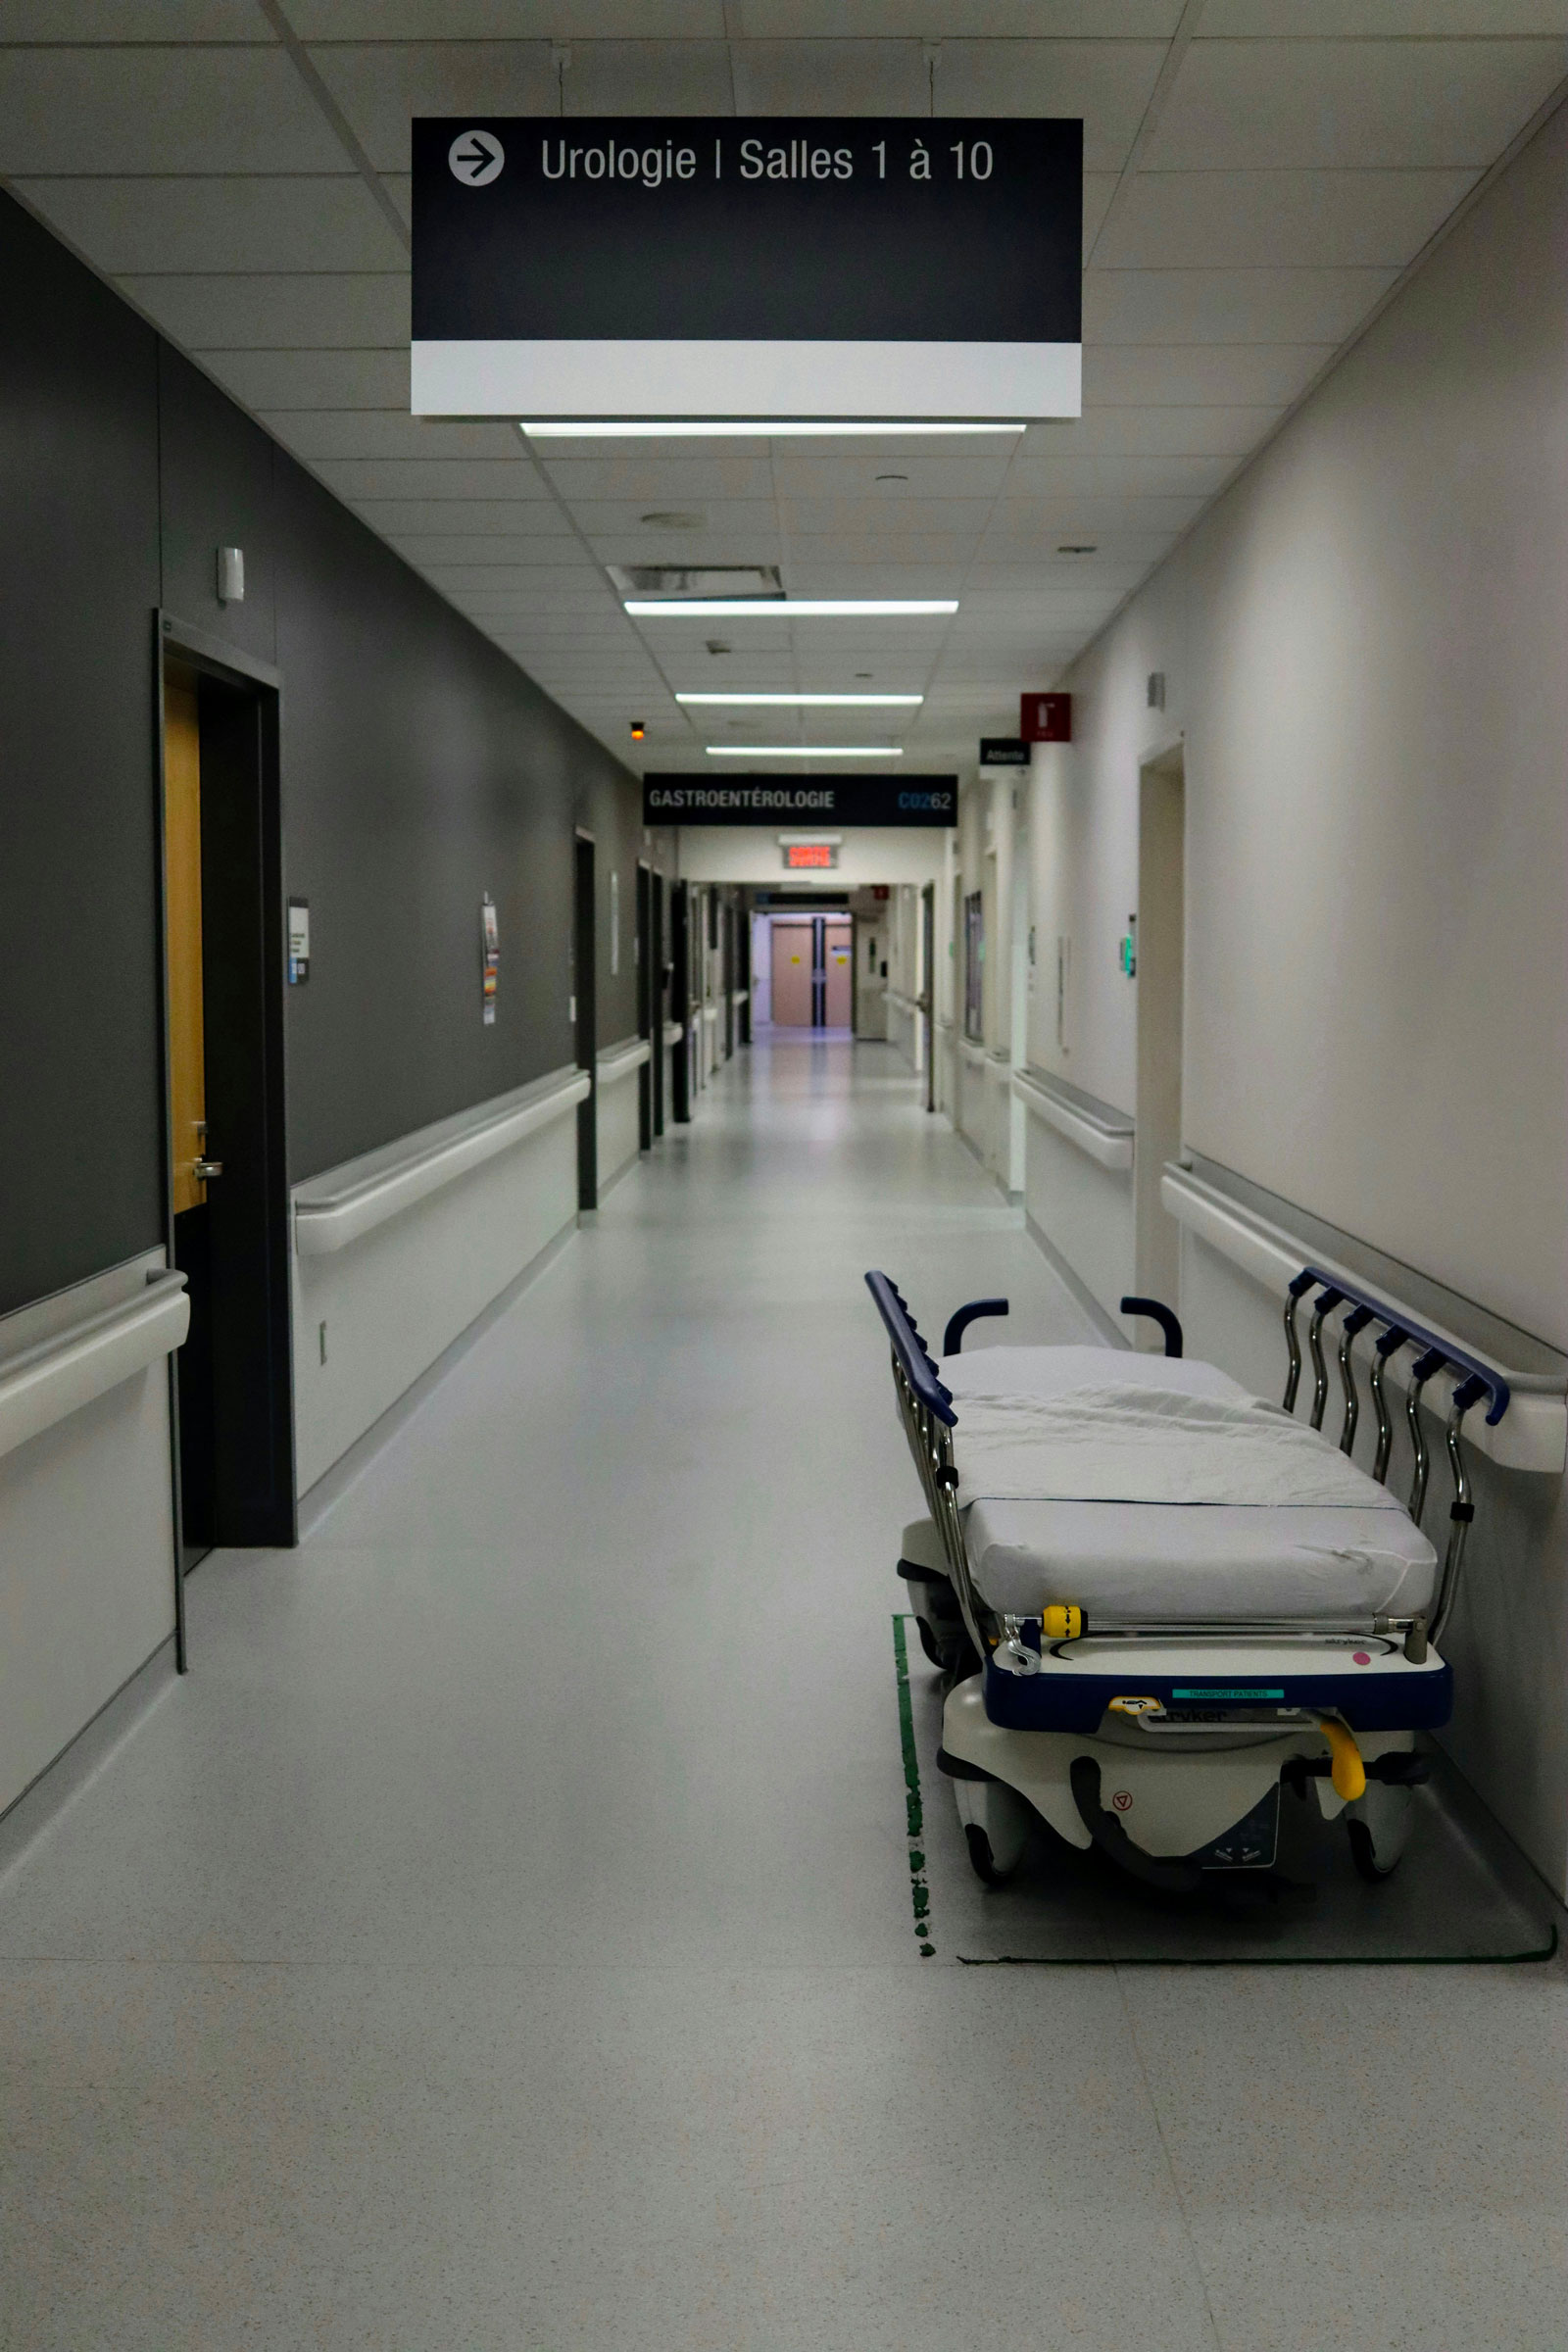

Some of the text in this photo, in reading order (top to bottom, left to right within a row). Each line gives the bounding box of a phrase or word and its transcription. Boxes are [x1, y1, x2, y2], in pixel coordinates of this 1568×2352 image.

[542, 139, 696, 188] Urologie
[740, 139, 854, 179] Salles
[871, 140, 885, 179] 1
[909, 138, 932, 179] à
[950, 141, 993, 179] 10
[986, 749, 1024, 760] Attente
[649, 787, 835, 808] GASTROENTÉROLOGIE
[1189, 1690, 1267, 1698] TRANSPORT PATIENTS
